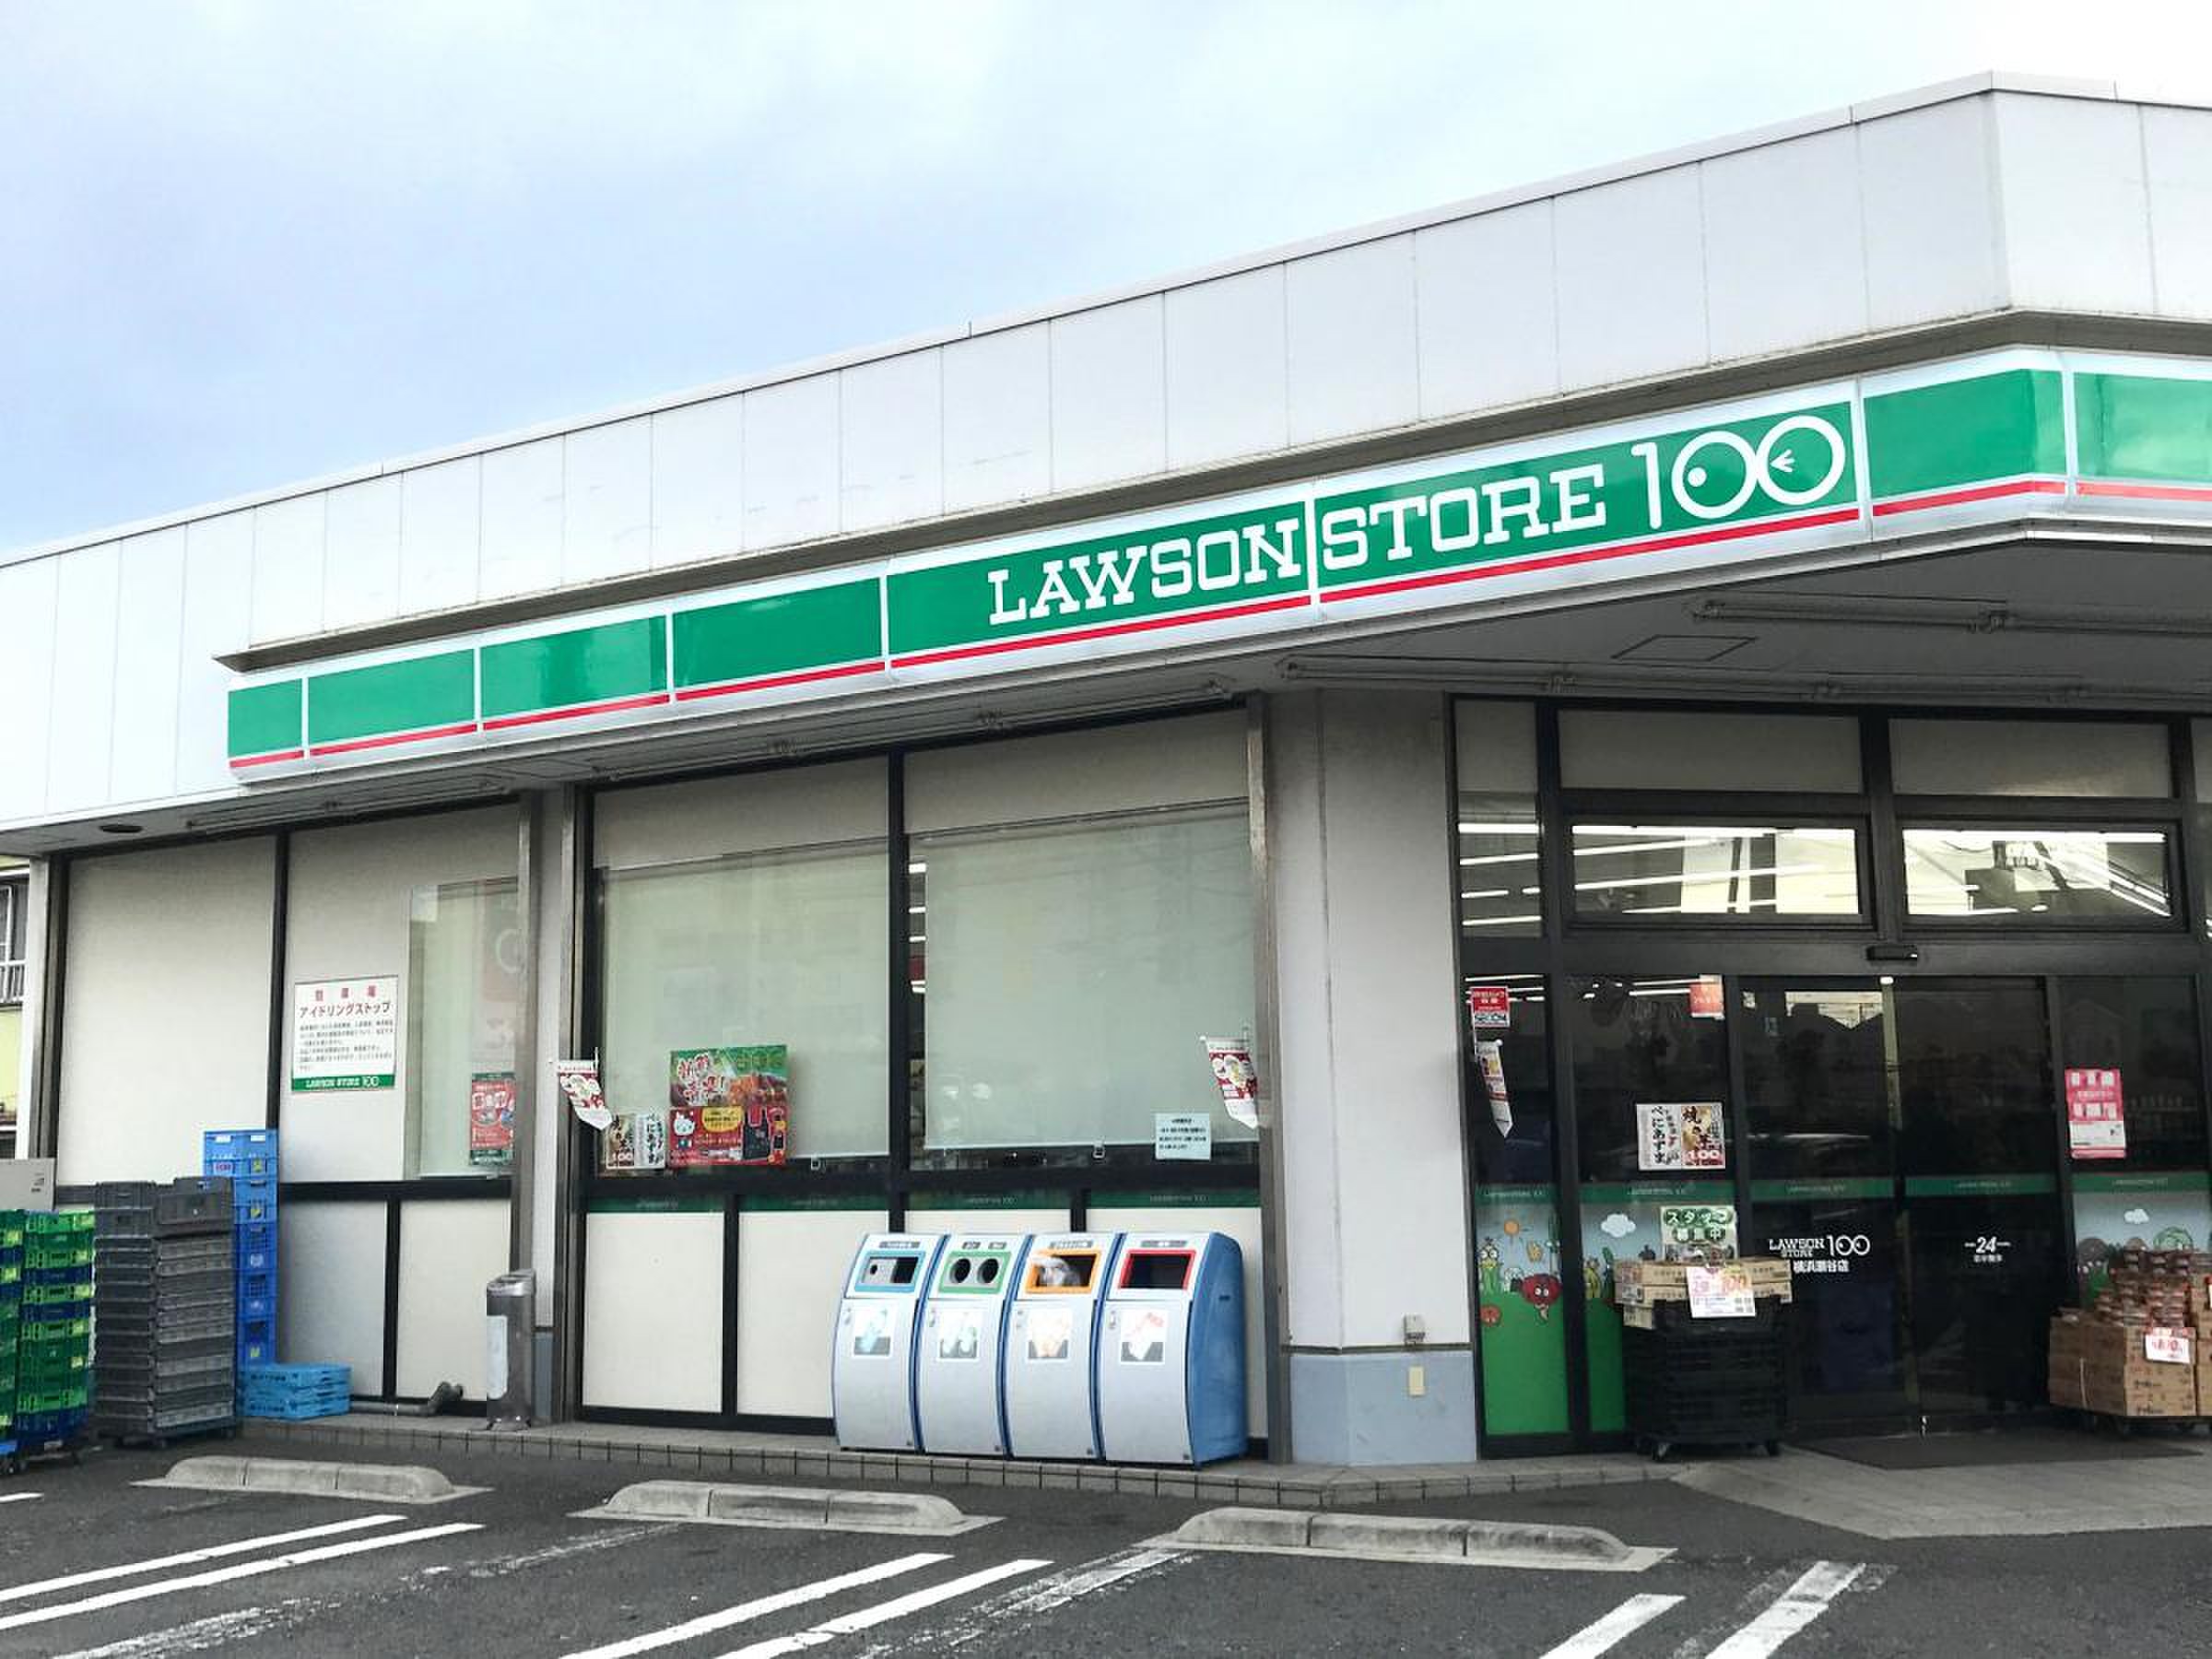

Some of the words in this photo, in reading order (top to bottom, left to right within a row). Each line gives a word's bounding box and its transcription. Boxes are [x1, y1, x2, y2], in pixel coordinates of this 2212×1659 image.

[989, 518, 1300, 626] LAWSON
[1322, 463, 1607, 571] STORE
[1632, 416, 1845, 530] 100
[300, 1002, 392, 1018] アイドリングストップ
[1768, 1238, 1825, 1250] LAWSON
[1827, 1235, 1871, 1256] 100
[1975, 1236, 1997, 1253] 24
